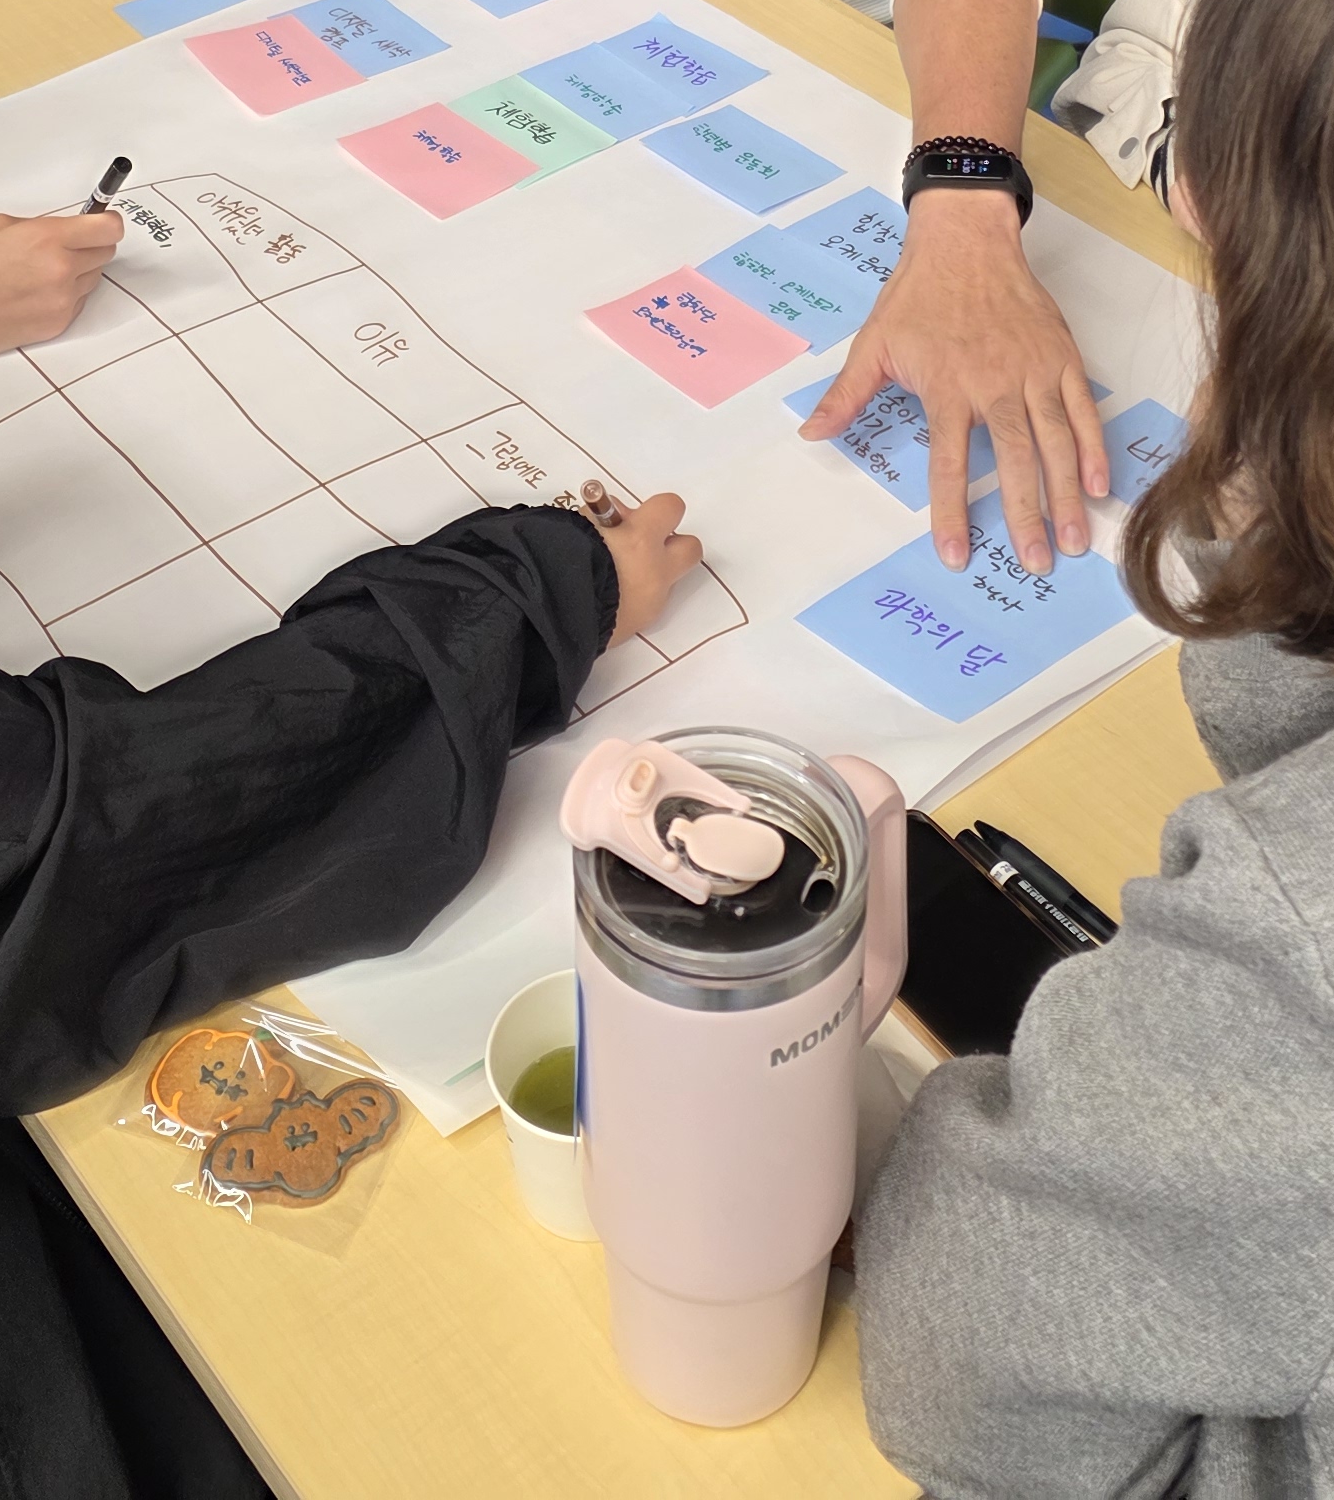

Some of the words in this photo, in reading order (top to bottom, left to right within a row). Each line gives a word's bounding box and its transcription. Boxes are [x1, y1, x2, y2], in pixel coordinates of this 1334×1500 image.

[329, 8, 378, 38] 디지털
[371, 40, 413, 58] 새싹
[634, 37, 718, 88] 체험학습
[197, 192, 265, 245] 아쉬웠던
[264, 233, 307, 264] 활동
[354, 322, 409, 367] 이유
[875, 589, 964, 650] 과학의
[960, 644, 1007, 676] 달
